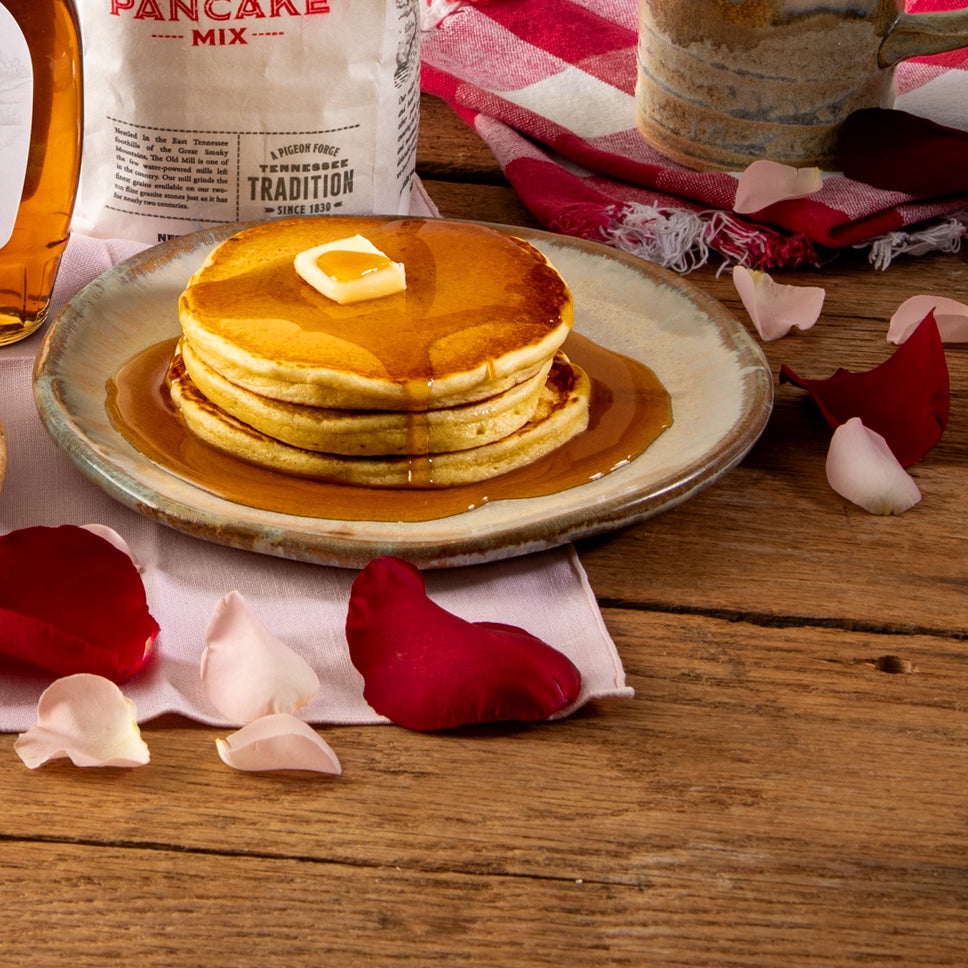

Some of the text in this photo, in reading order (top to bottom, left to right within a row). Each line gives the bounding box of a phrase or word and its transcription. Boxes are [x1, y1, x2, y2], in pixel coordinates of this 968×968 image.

[192, 28, 248, 46] MIX
[114, 127, 137, 139] Nestled
[155, 136, 166, 144] the
[115, 137, 140, 148] foothills
[270, 143, 340, 160] A PIGEON FORGE
[124, 165, 133, 173] the
[194, 176, 214, 184] grinds
[260, 159, 349, 173] TENNESSEE
[248, 169, 354, 200] TRADITION
[277, 202, 331, 215] SINCE 1830
[157, 233, 182, 242] NE
